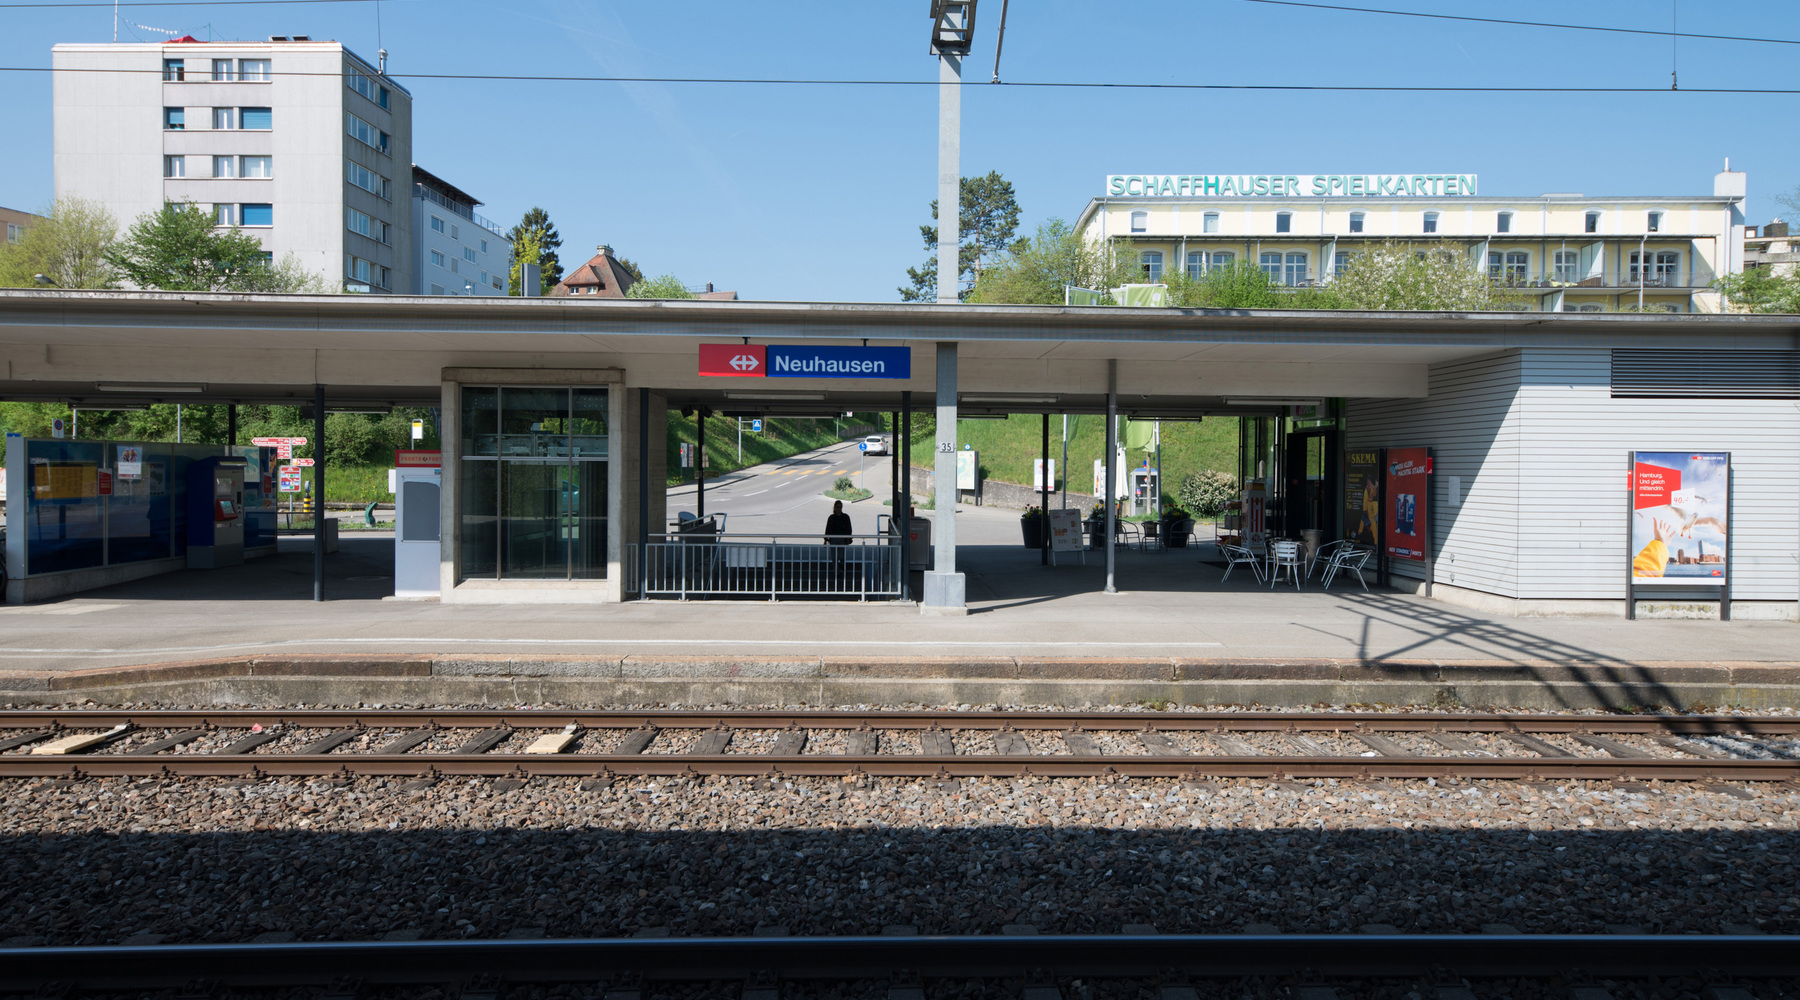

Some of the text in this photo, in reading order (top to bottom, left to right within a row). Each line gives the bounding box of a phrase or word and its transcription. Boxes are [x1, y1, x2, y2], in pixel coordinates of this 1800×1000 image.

[1109, 175, 1476, 196] SCHAFFHAUSER SPIELKARTEN
[775, 355, 885, 373] Neuhausen
[941, 442, 952, 452] 35
[1351, 453, 1376, 464] SKEMA
[1412, 465, 1426, 475] STARK
[1639, 472, 1663, 480] Hamburg.
